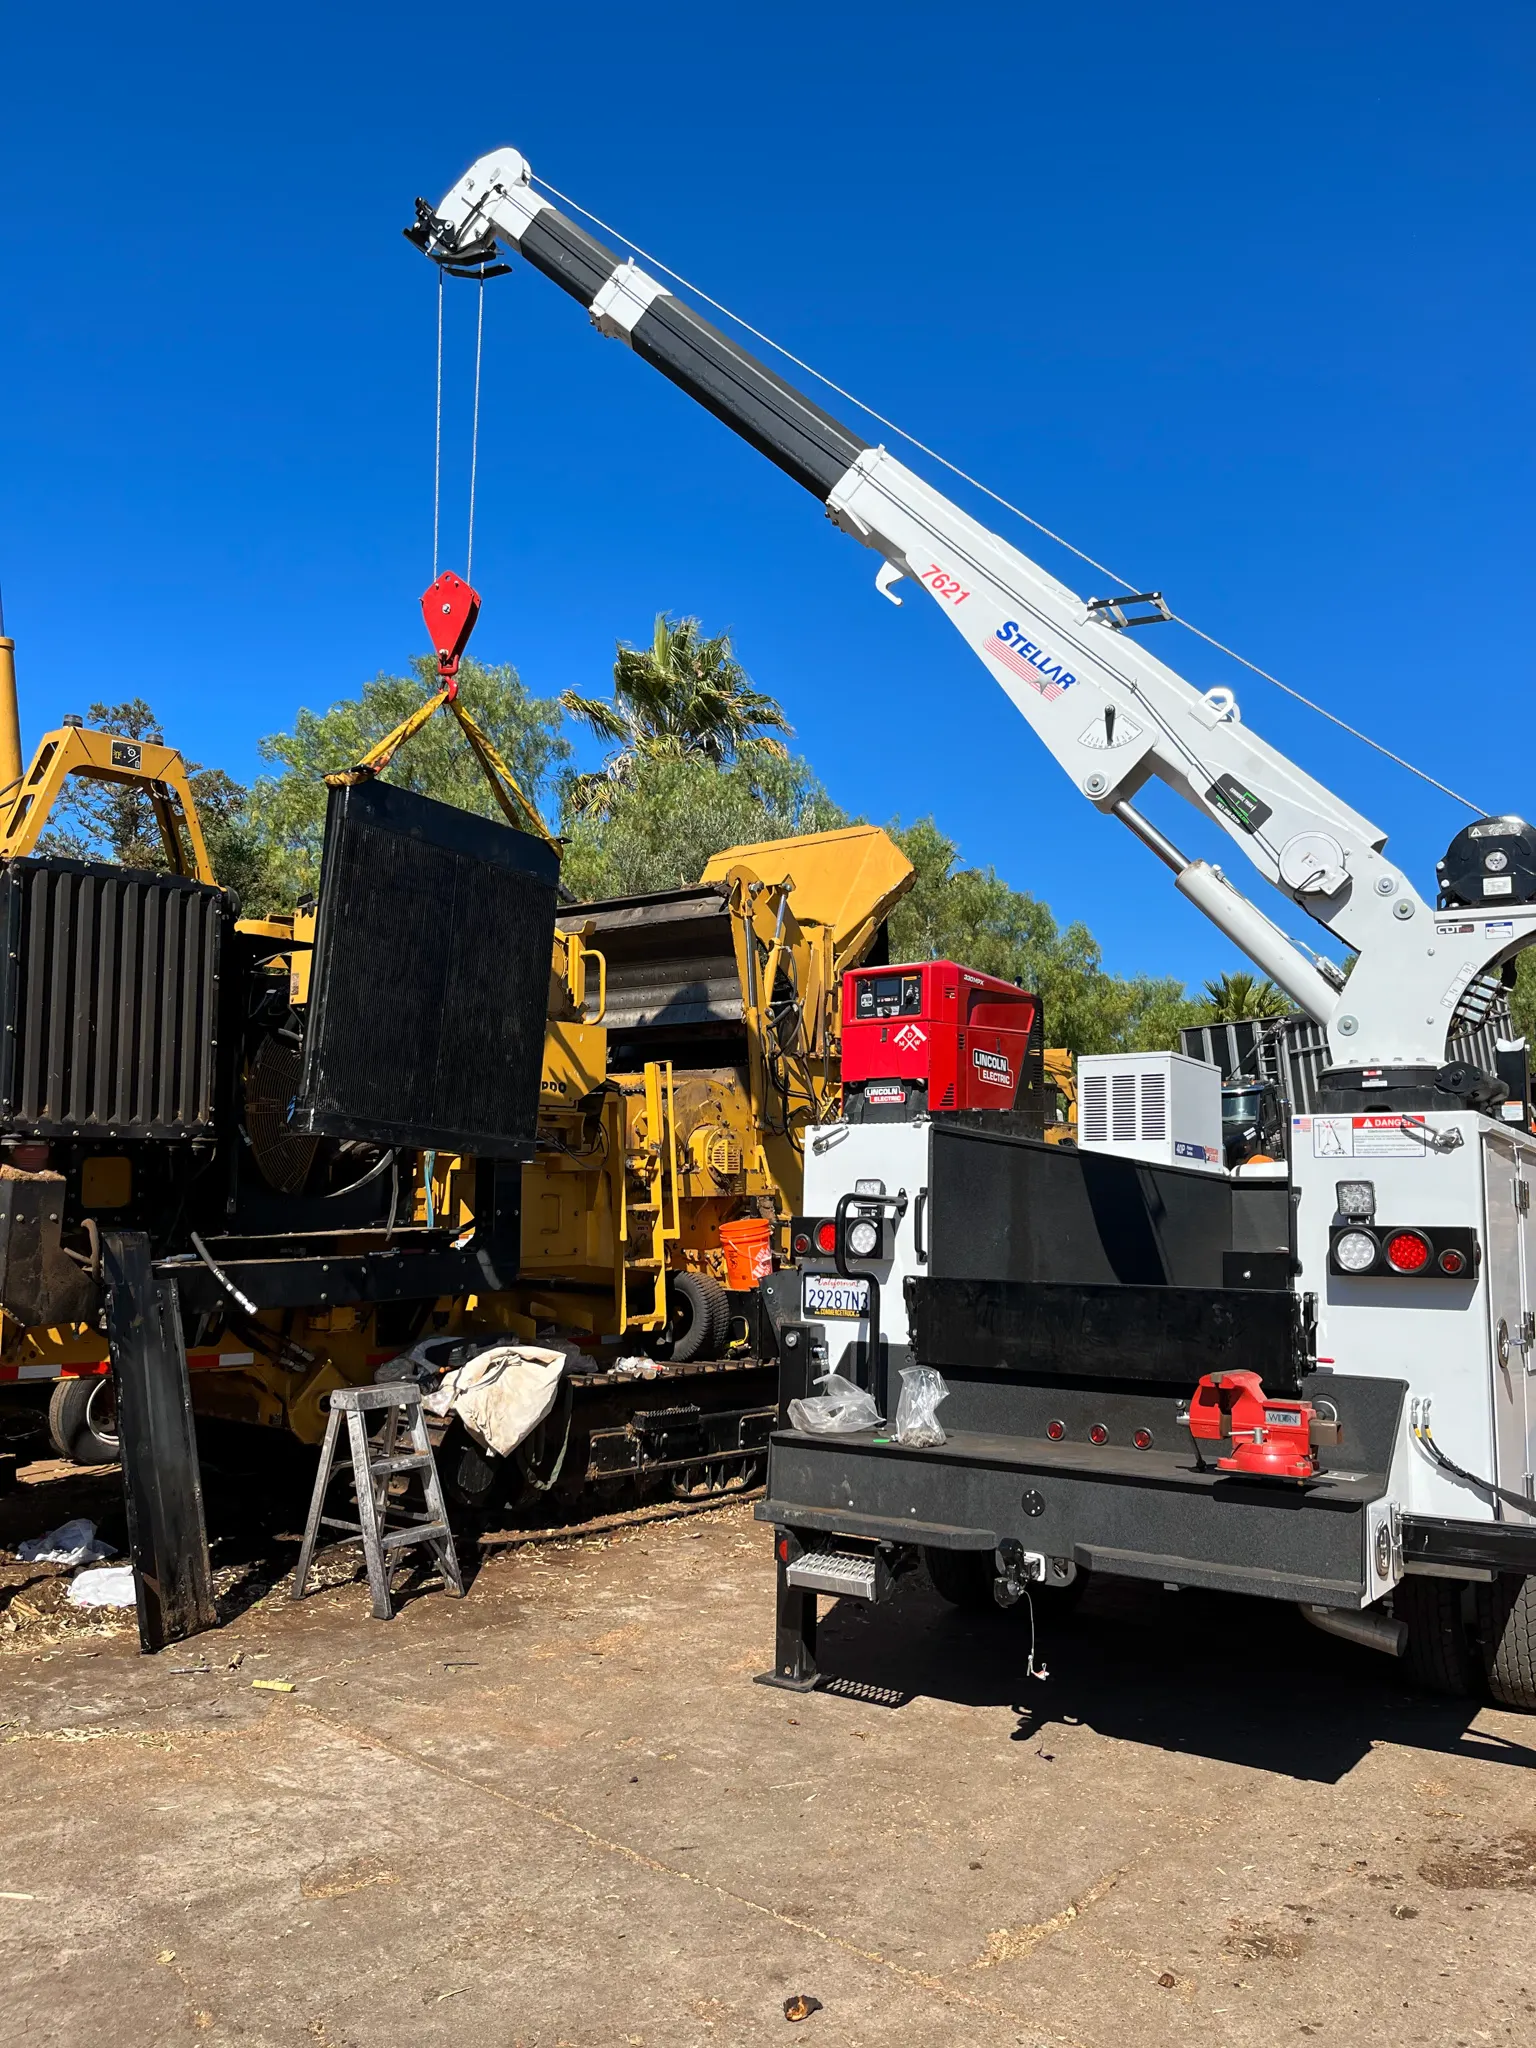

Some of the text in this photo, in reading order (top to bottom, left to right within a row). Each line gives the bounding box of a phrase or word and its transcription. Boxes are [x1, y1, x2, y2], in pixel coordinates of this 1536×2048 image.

[921, 563, 970, 606] 7621
[996, 621, 1076, 690] STELLAR
[974, 1052, 1007, 1072] LINCOLN
[982, 1069, 1011, 1085] ELECTRIC
[867, 1088, 898, 1097] LINCOLN
[808, 1288, 868, 1310] 29287N3
